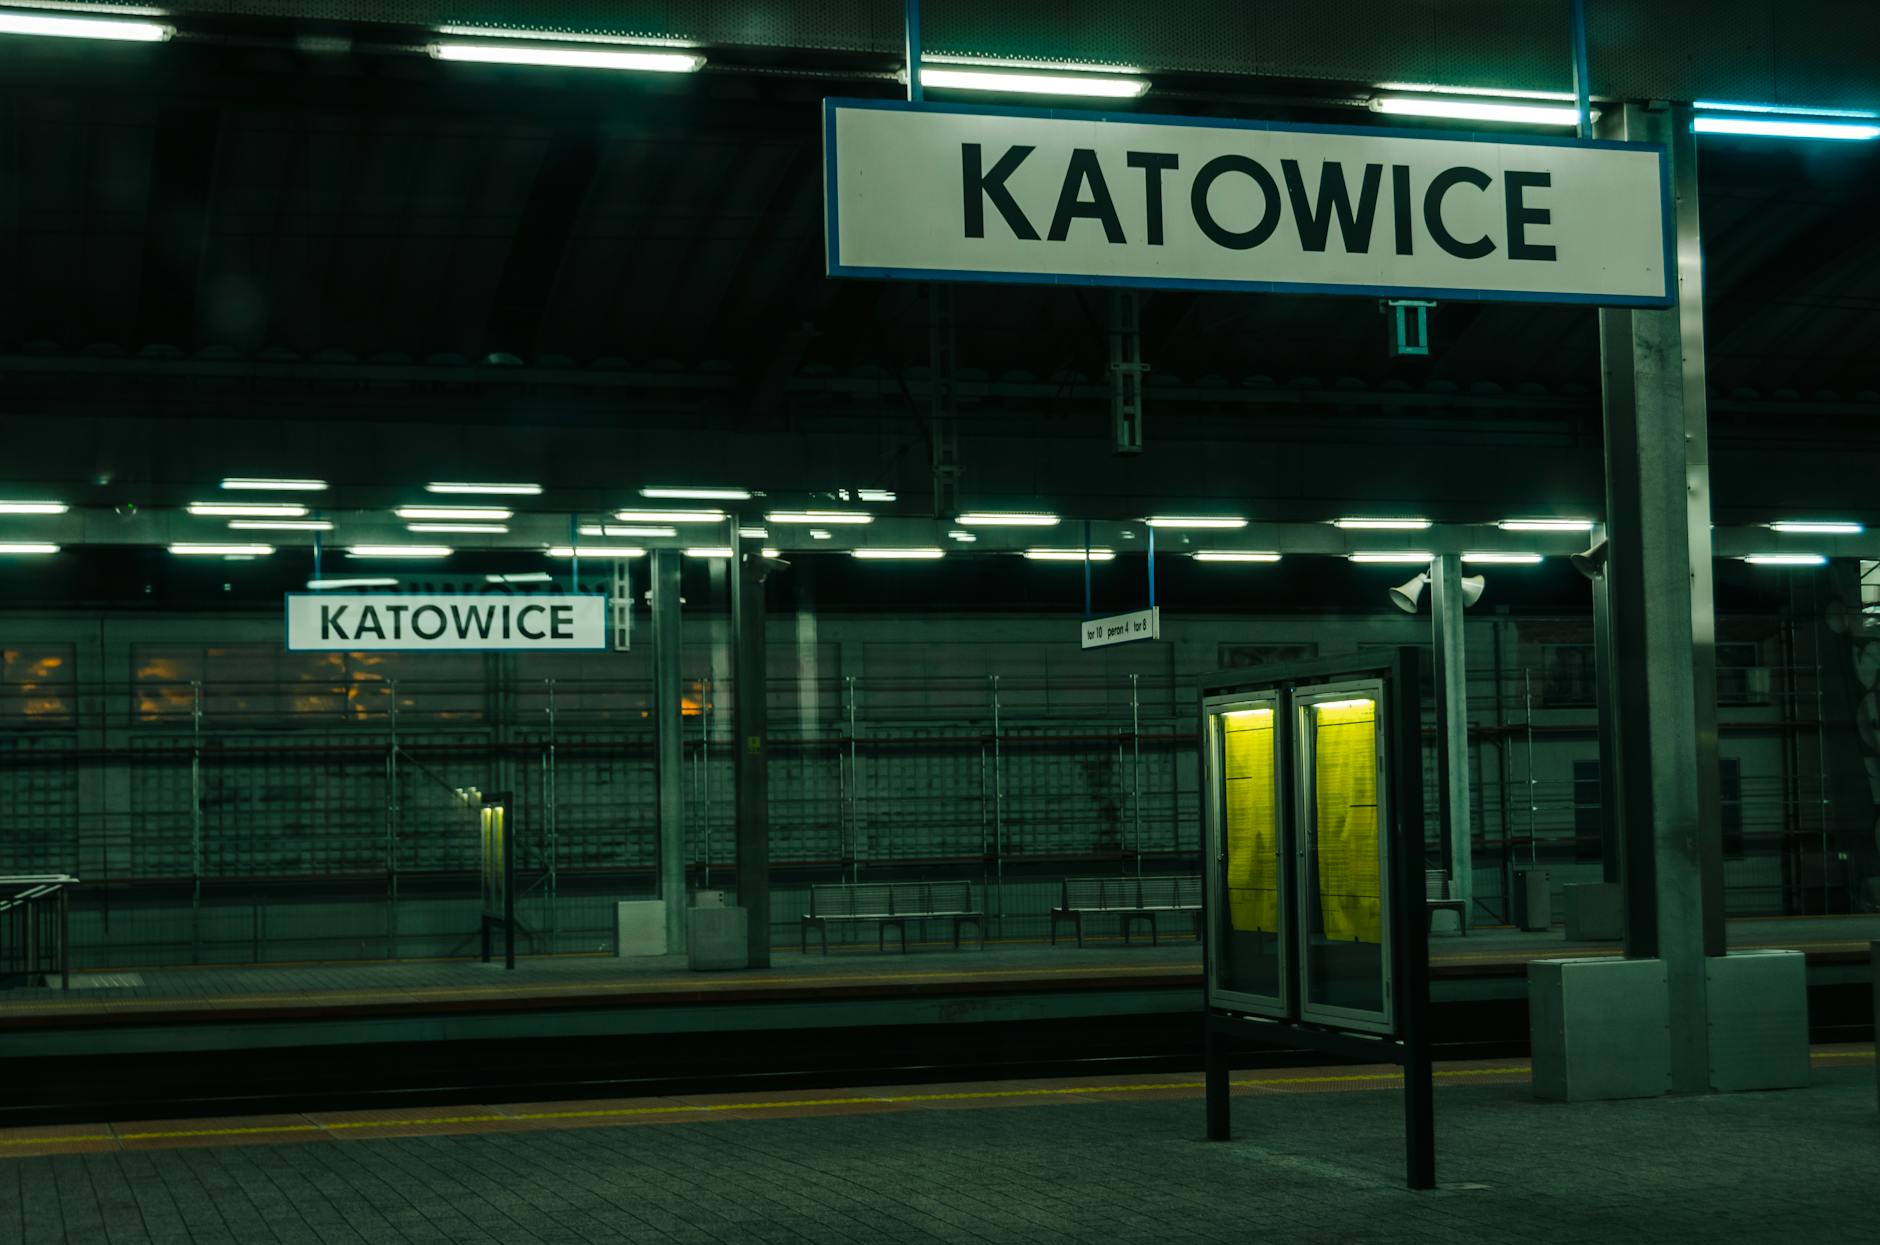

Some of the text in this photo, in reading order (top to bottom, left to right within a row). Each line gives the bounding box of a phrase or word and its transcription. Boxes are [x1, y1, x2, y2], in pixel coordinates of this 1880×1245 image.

[961, 143, 1557, 261] KATOWICE
[321, 604, 574, 640] KATOWICE
[1087, 618, 1147, 640] tor 10 peron 4 tor 8
